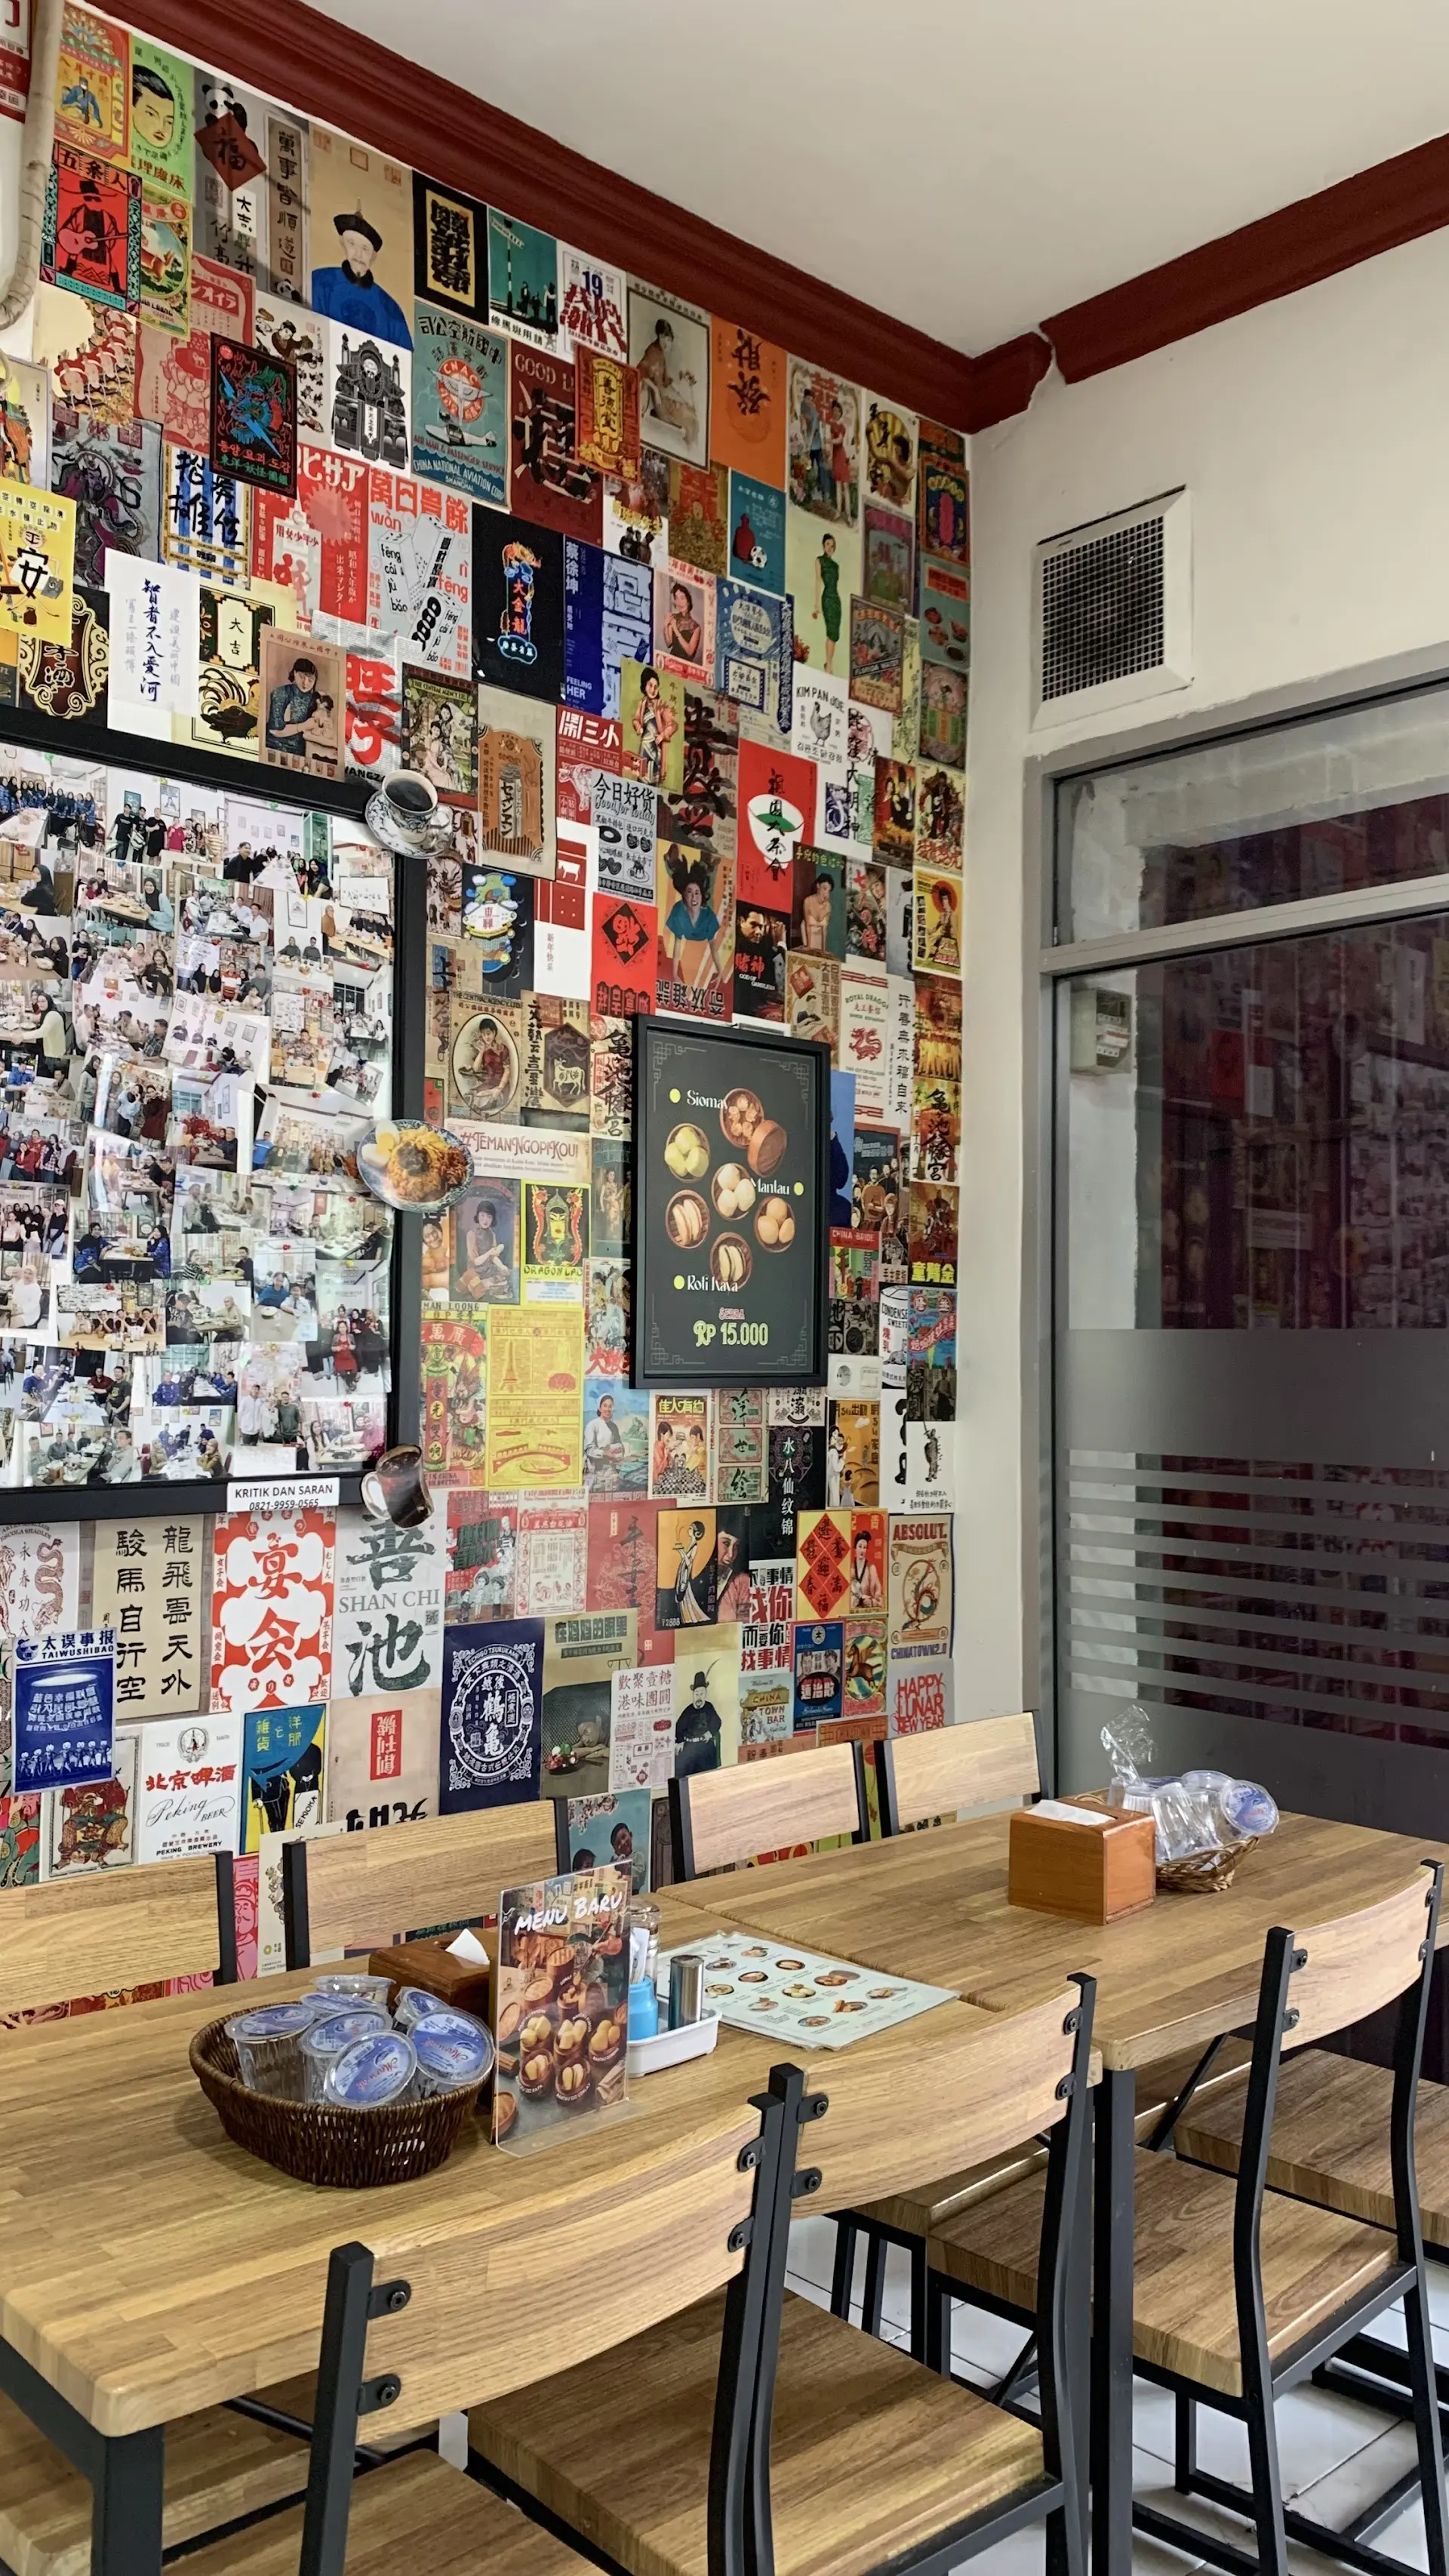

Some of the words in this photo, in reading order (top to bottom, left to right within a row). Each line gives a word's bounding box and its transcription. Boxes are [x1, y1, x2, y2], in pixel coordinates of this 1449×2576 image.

[582, 269, 604, 297] 19
[515, 352, 557, 385] GOOD
[413, 457, 432, 472] CHINA
[432, 459, 463, 479] NATIONAL
[463, 466, 491, 491] AVIATION
[565, 540, 580, 596] 蔡徐坤
[229, 617, 245, 656] 大吉
[566, 676, 593, 692] FEELING
[566, 684, 586, 700] HER
[796, 686, 811, 698] KIM
[811, 688, 829, 703] PAN
[845, 993, 866, 1005] ROYAL
[524, 1265, 564, 1276] DRAGON
[687, 1274, 708, 1292] Roti
[423, 1302, 445, 1311] MAN
[448, 1302, 481, 1312] LOONG
[692, 1319, 718, 1348] RP
[719, 1320, 771, 1347] 15.000
[235, 1488, 270, 1500] KRITIK
[272, 1487, 297, 1497] DAN
[298, 1484, 333, 1495] SARAN
[248, 1497, 319, 1512] 0821-9959-0565
[161, 1525, 194, 1697] 龍飛雲天外
[339, 1593, 396, 1614] SHAN
[402, 1588, 441, 1608] CHI
[115, 1529, 149, 1705] 駿馬自行空
[42, 1630, 114, 1651] 太误事报
[41, 1644, 114, 1660] TAIWUSHIBAO
[344, 1613, 432, 1697] 池
[897, 1672, 943, 1695] HAPPY
[758, 1706, 786, 1716] TOWN
[897, 1693, 944, 1719] LUNAR
[767, 1715, 786, 1725] BAR
[918, 1713, 944, 1731] YEAR
[145, 1763, 238, 1793] 北京啤酒
[146, 1795, 219, 1827] Peking
[200, 1808, 230, 1823] BEER
[155, 1845, 182, 1856] PEKING
[187, 1840, 223, 1852] BREWERY
[514, 1904, 568, 1937] MENU
[573, 1890, 623, 1922] BARU
